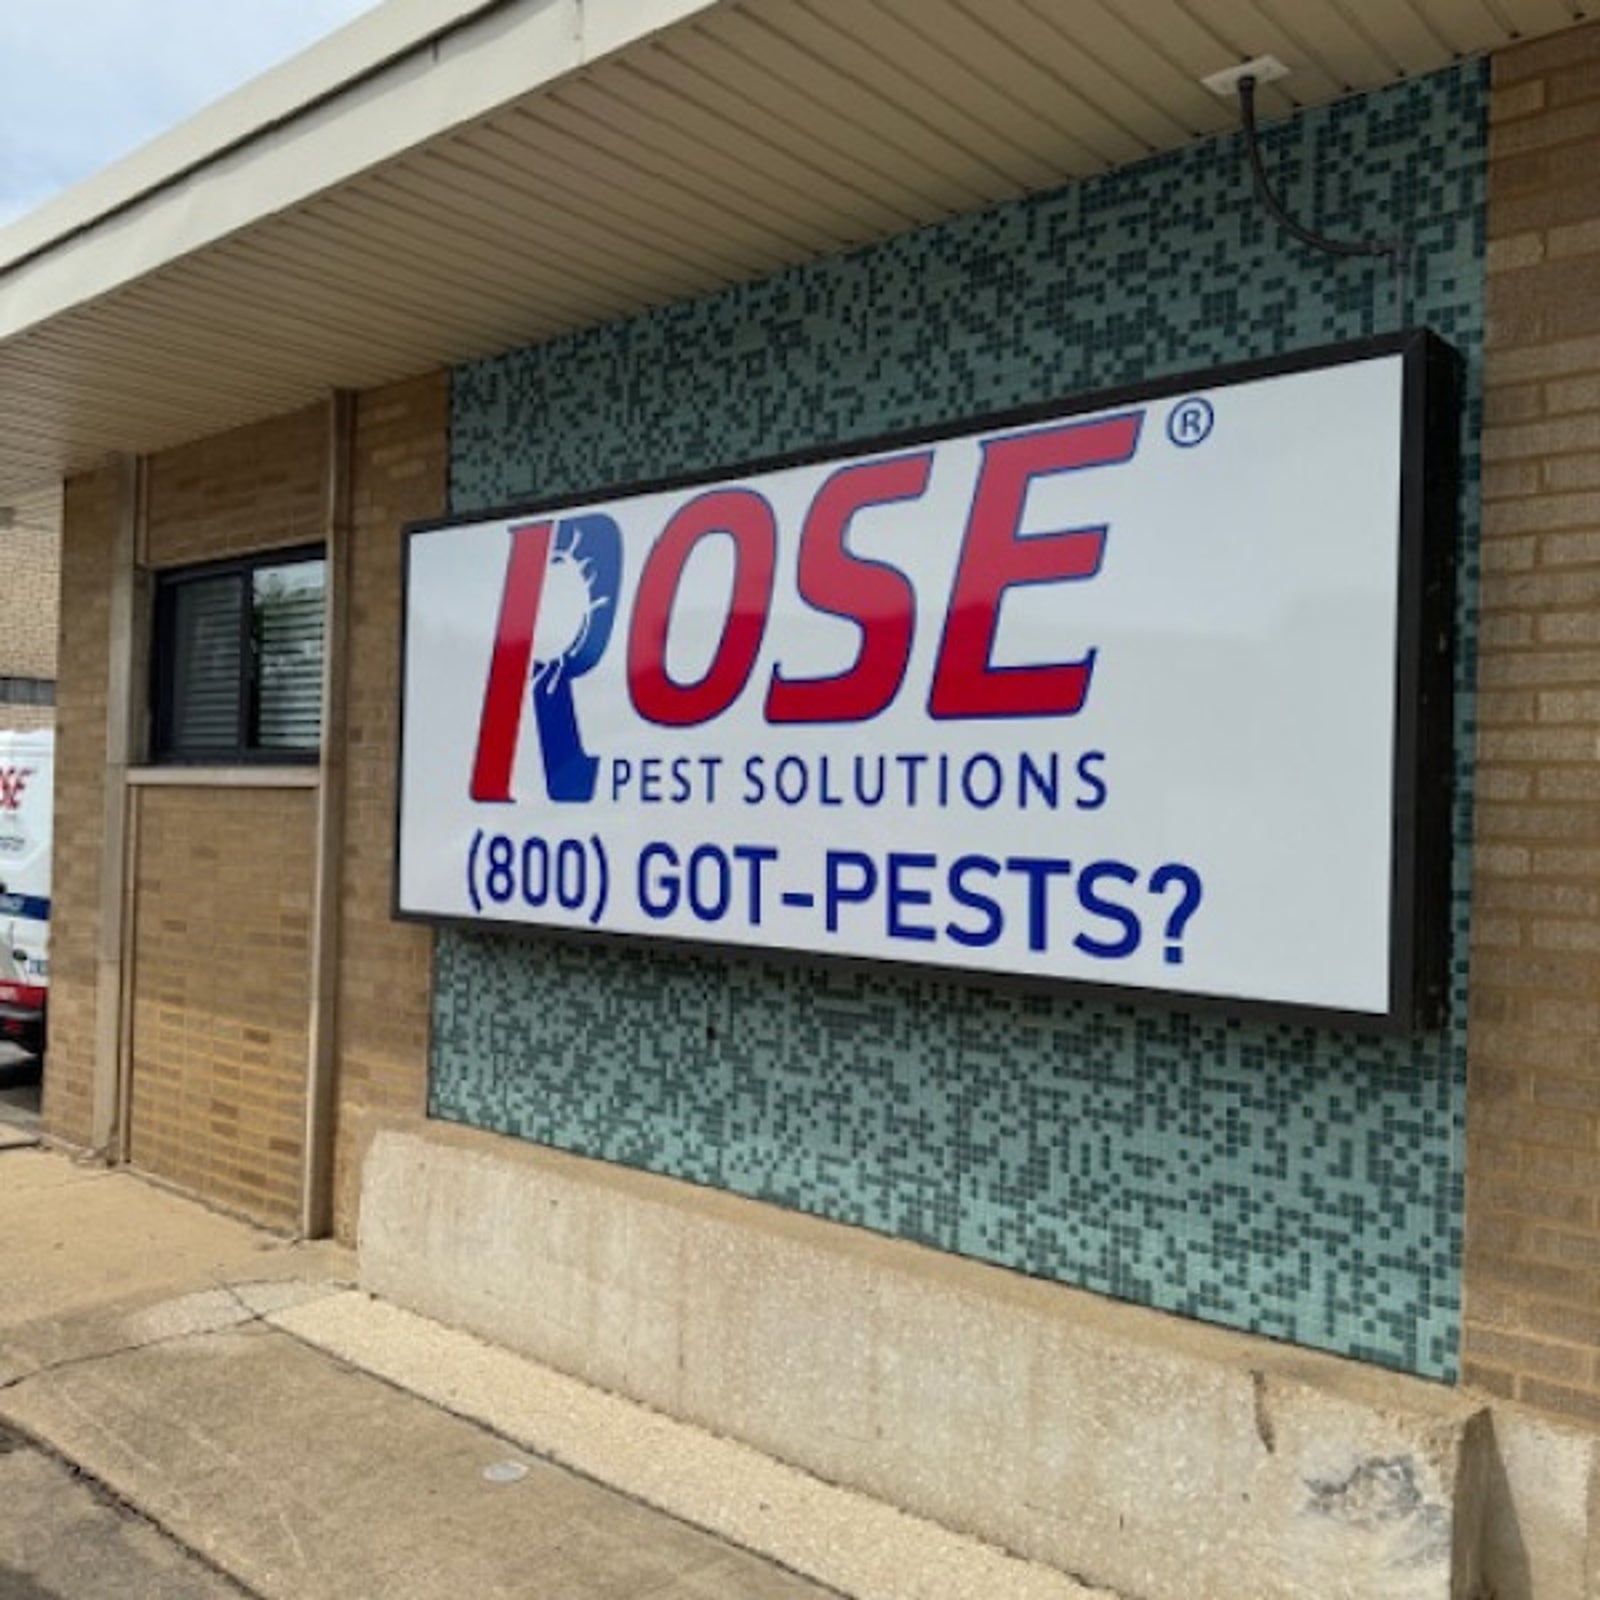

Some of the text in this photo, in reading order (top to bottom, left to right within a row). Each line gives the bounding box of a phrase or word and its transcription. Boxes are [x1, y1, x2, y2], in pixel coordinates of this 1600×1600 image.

[470, 410, 1146, 806] ROSE
[611, 750, 1108, 811] PEST SOLUTIONS
[466, 828, 1204, 964] (800) GOT-PESTS?
